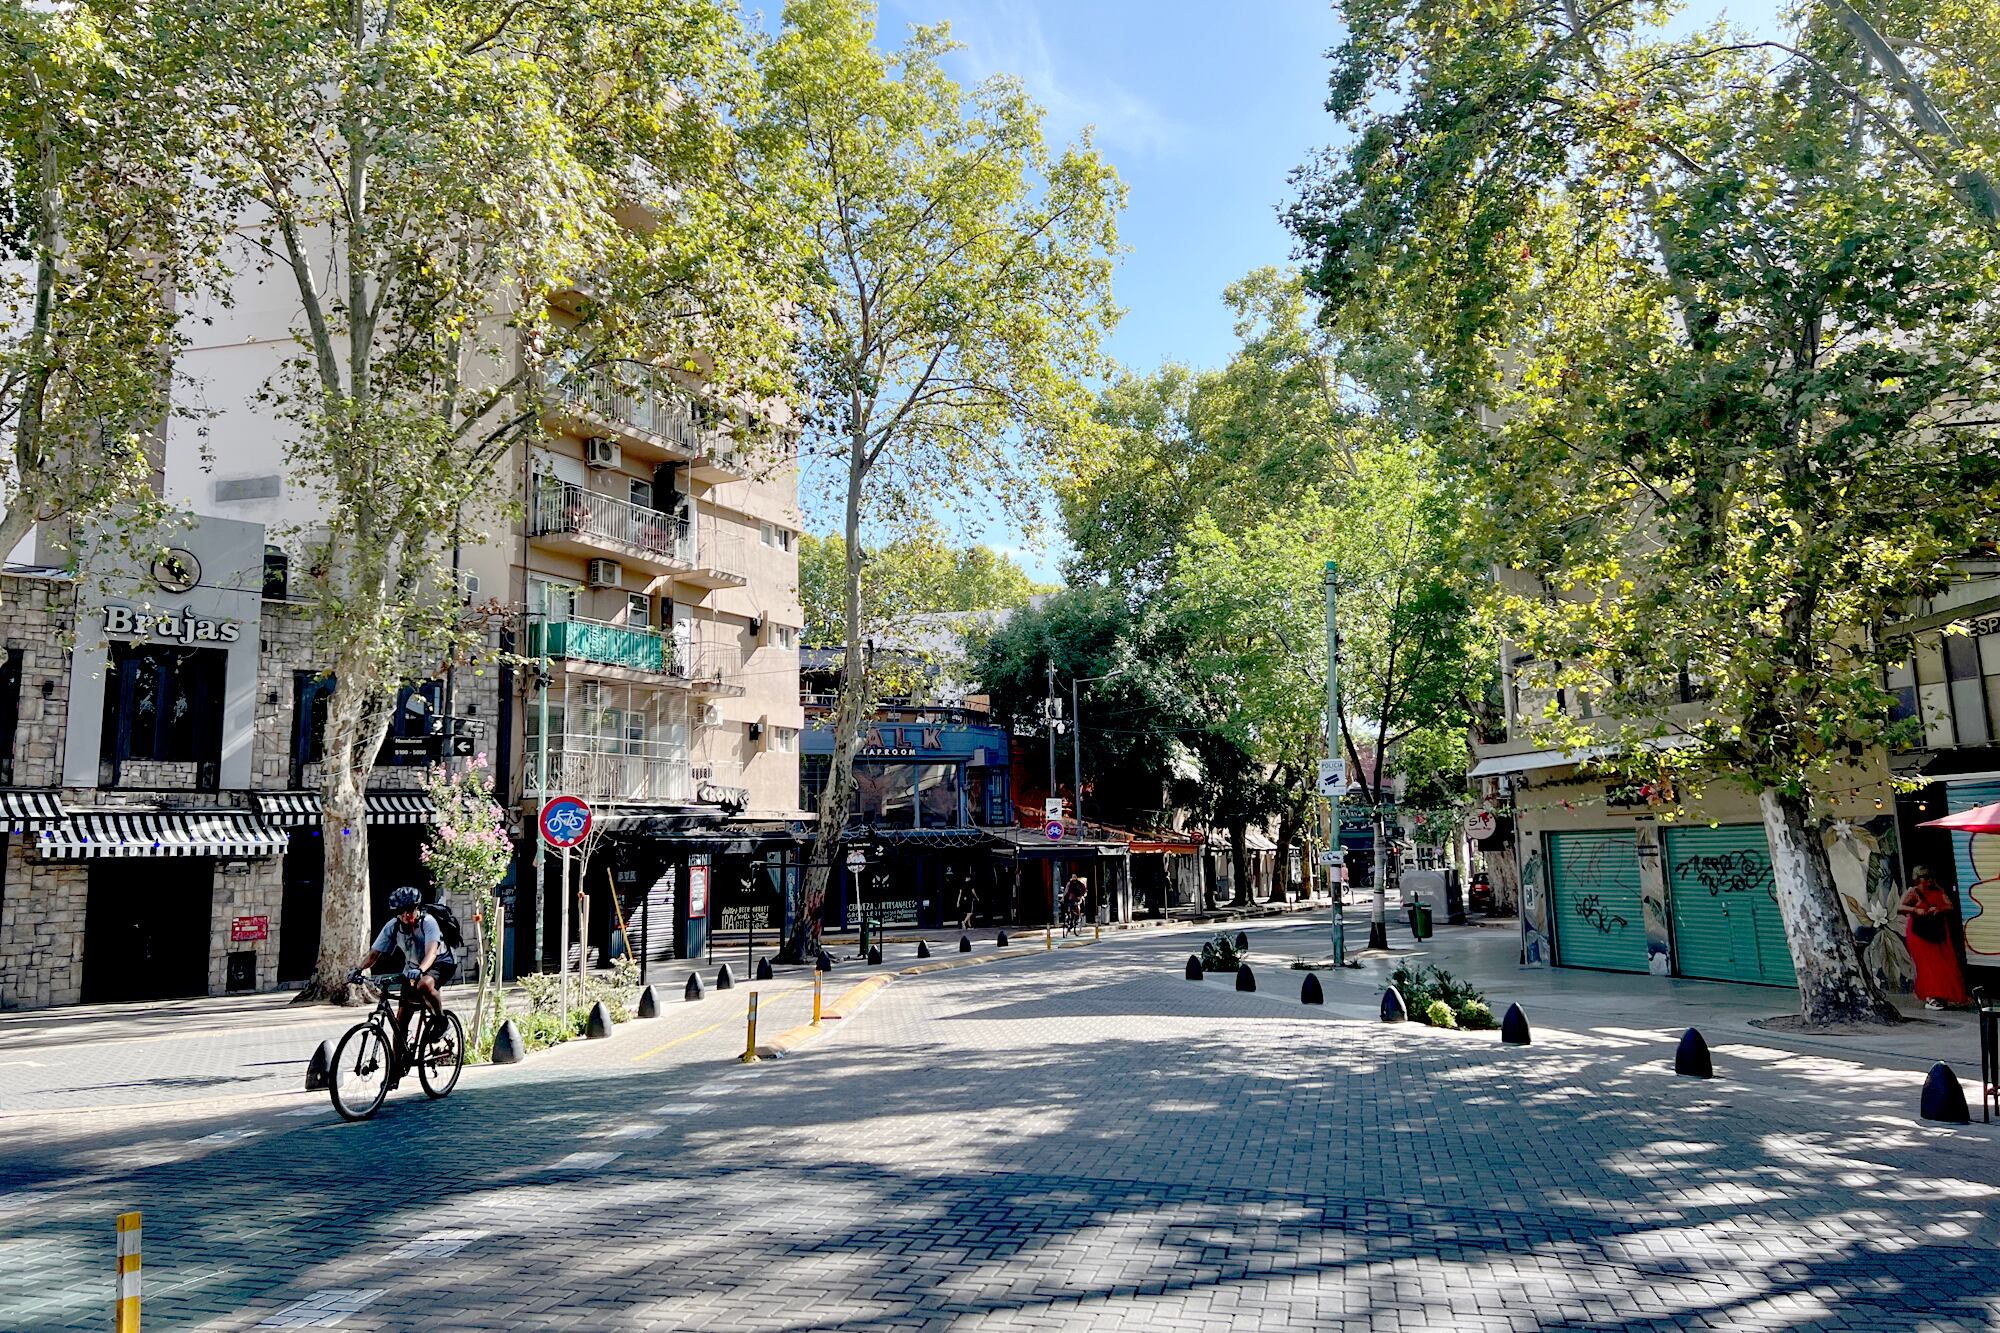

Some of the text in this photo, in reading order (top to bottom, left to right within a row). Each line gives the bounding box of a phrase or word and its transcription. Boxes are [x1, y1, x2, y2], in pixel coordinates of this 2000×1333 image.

[103, 604, 241, 645] Brujas
[832, 727, 943, 749] ALK
[863, 748, 916, 756] TAPROOM
[721, 914, 735, 930] IPA
